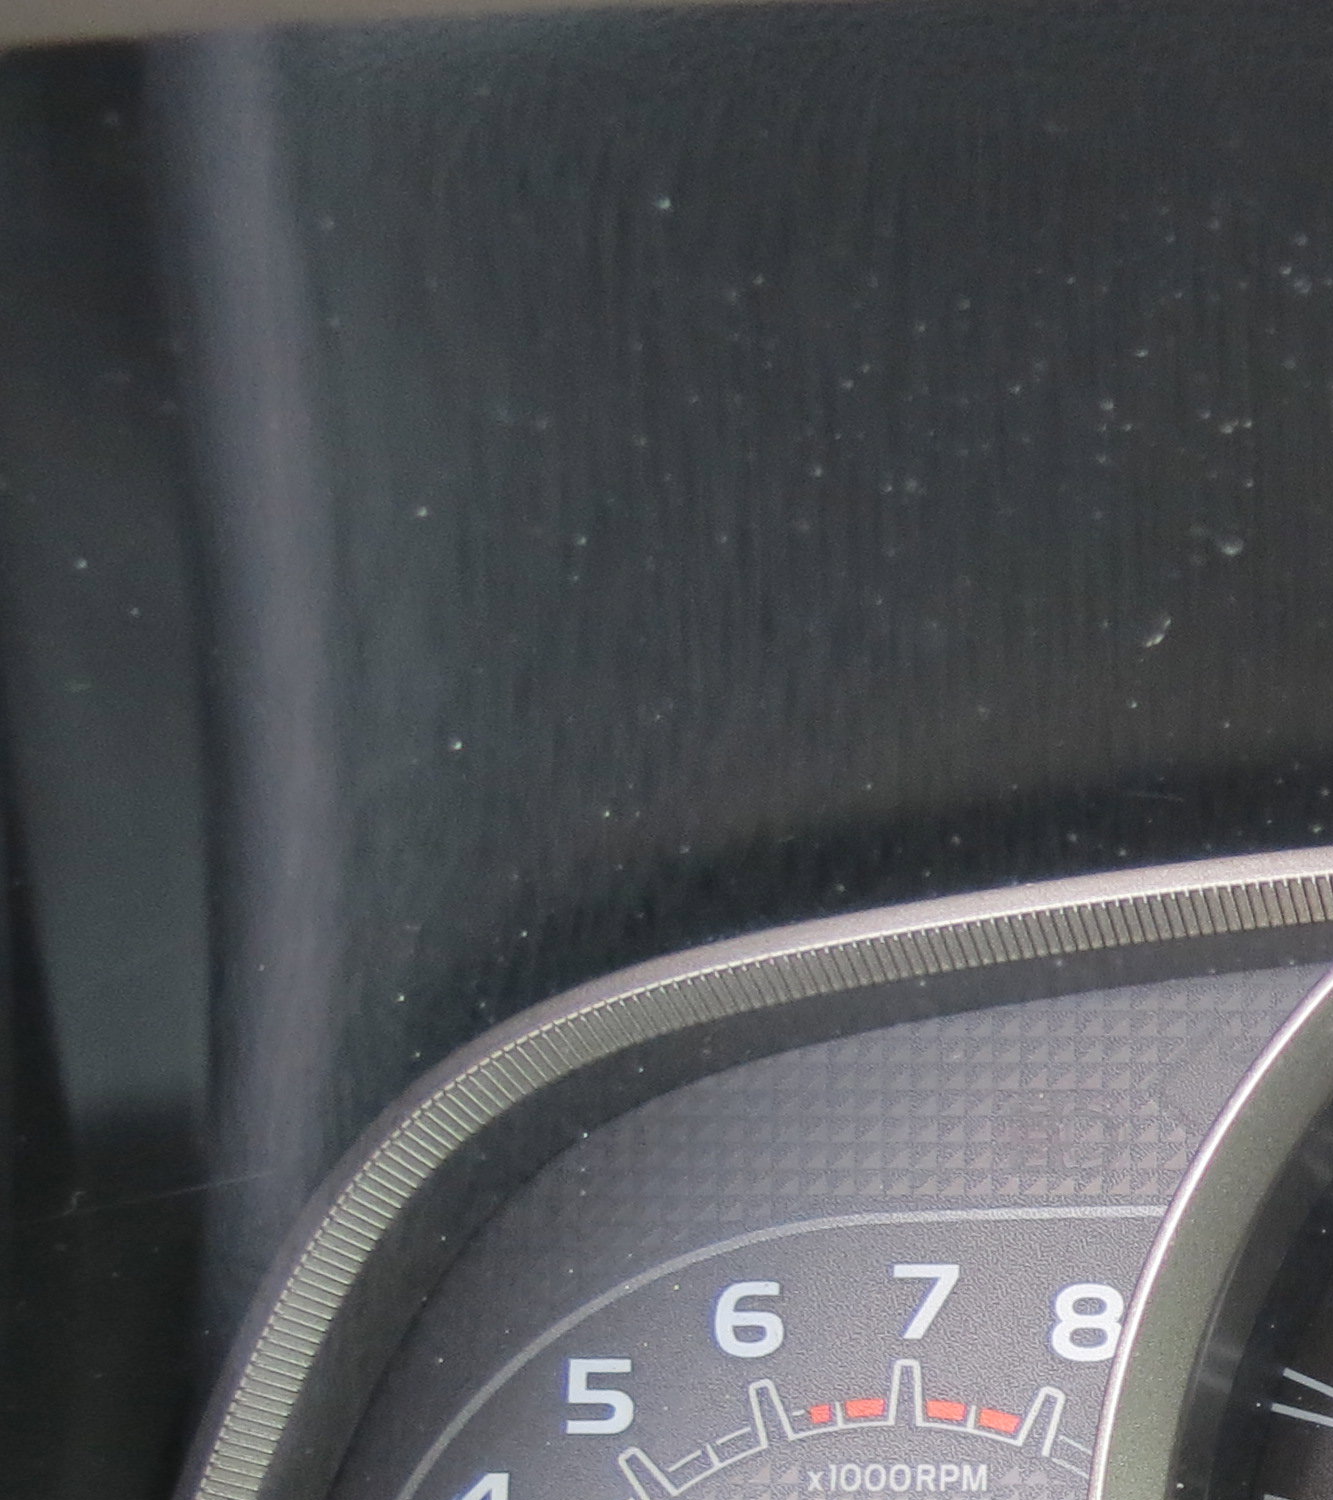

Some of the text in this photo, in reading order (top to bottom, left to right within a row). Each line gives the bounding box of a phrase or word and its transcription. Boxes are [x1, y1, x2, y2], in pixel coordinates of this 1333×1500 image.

[713, 1280, 785, 1359] 6
[892, 1263, 961, 1341] 7
[1050, 1281, 1125, 1363] 8
[565, 1357, 635, 1436] 5
